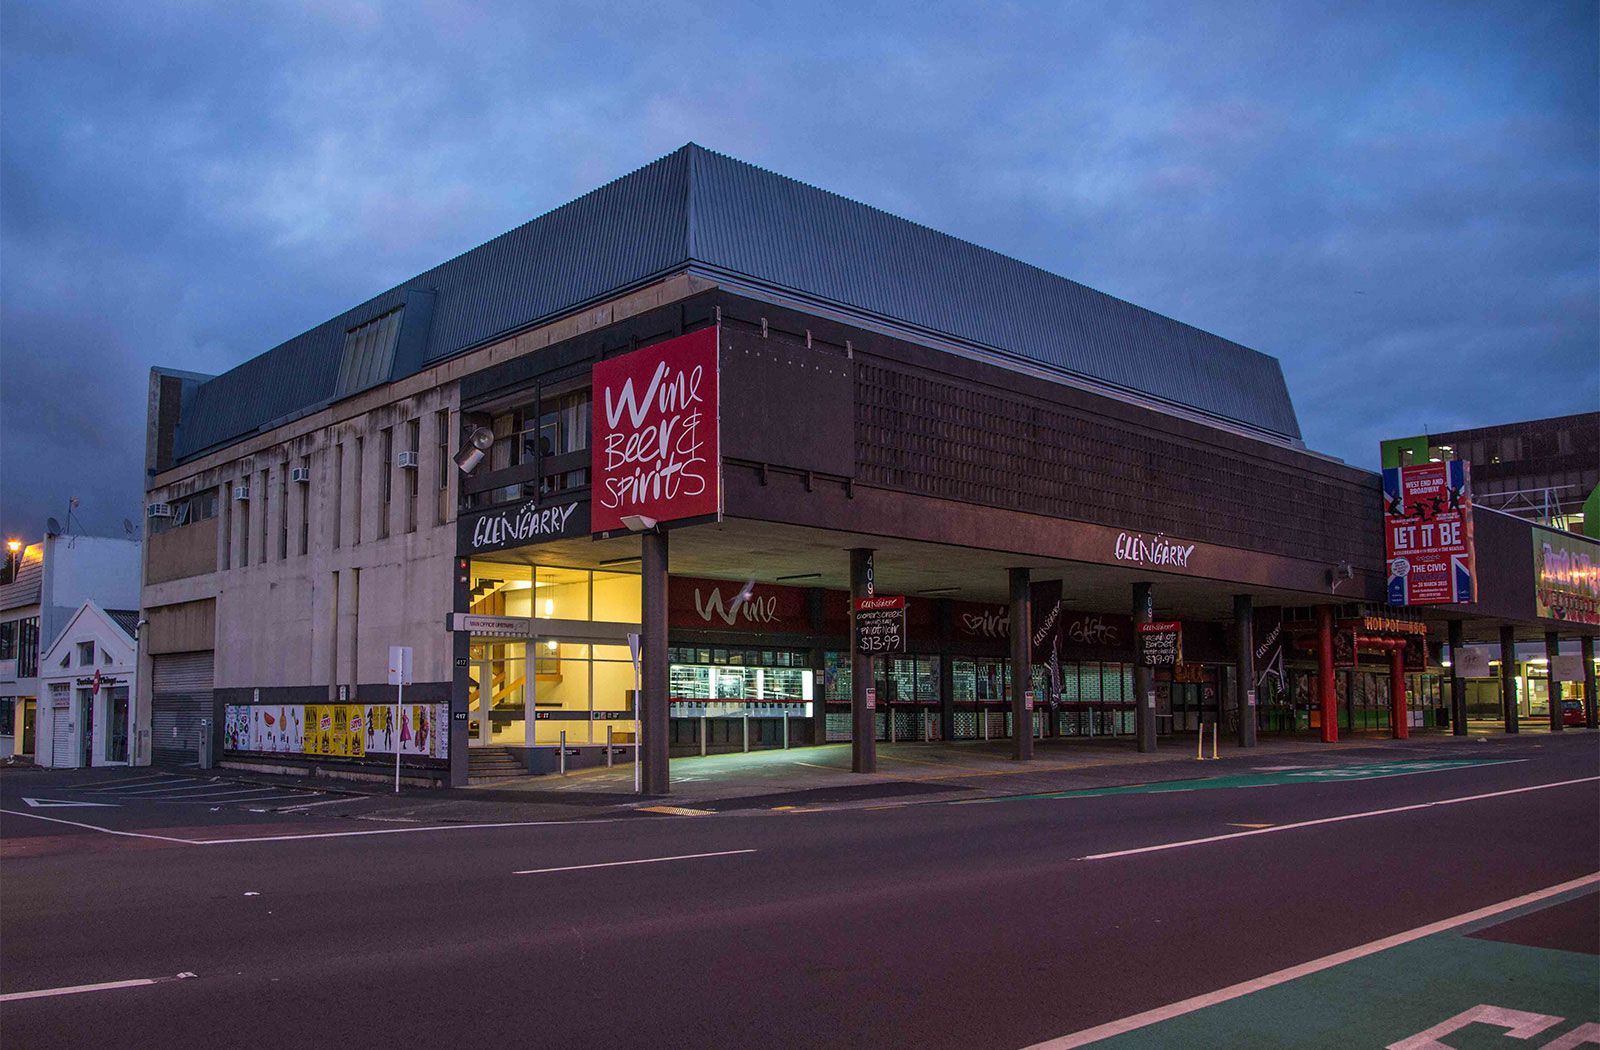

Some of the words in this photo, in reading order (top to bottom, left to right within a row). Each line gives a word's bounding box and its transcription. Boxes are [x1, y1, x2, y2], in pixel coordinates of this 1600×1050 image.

[605, 361, 703, 430] Wine
[604, 414, 681, 472] Beer
[676, 408, 705, 459] &
[472, 500, 578, 548] GLENGARRY
[1394, 526, 1417, 550] LET
[1439, 521, 1462, 546] BE
[1114, 532, 1194, 568] GLENGARRY
[1412, 565, 1427, 573] THE
[1426, 563, 1447, 572] CIVIC
[694, 579, 782, 626] Wine
[1365, 616, 1382, 631] HOT
[1385, 618, 1400, 633] POT
[860, 635, 900, 651] $13.99
